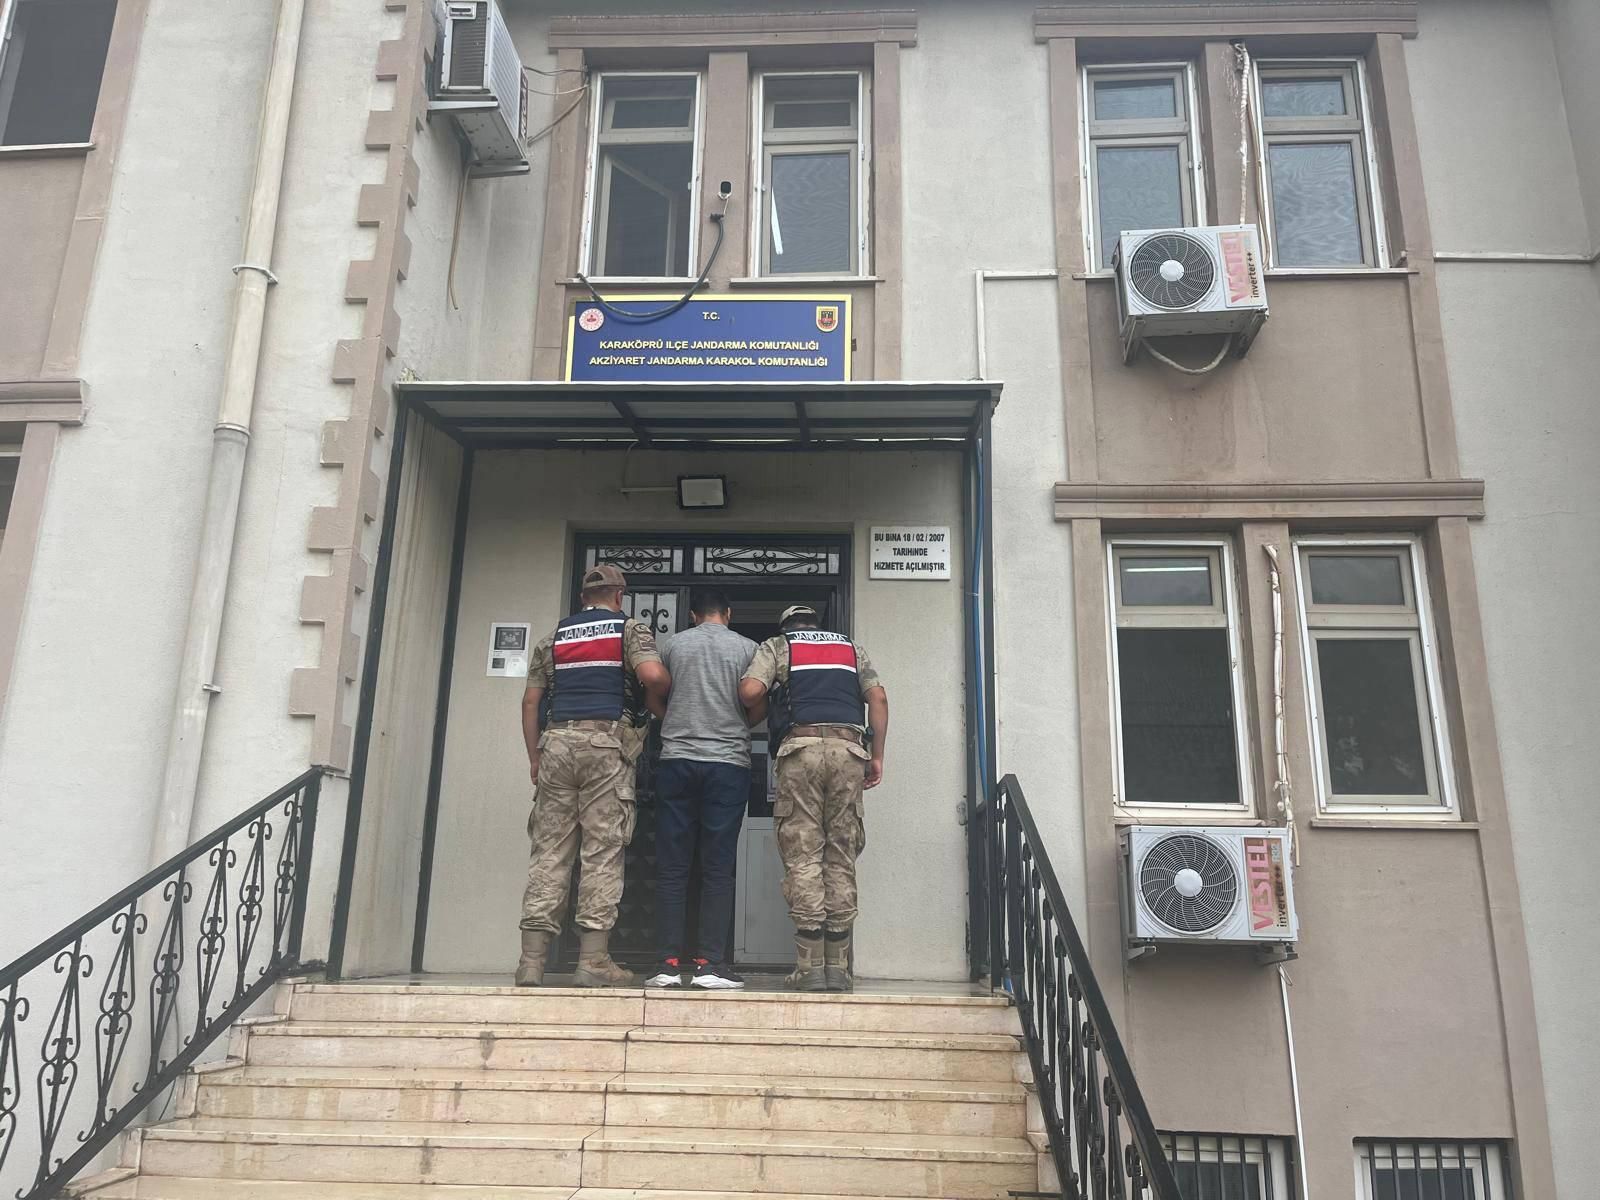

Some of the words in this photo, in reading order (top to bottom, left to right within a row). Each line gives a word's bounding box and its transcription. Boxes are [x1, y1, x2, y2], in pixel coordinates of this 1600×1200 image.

[702, 311, 720, 321] T.C.
[599, 339, 664, 350] KARAKÖPRÜ
[690, 340, 748, 350] JANDARMA
[749, 340, 819, 351] KOMUTANLIĞI
[589, 355, 646, 366] AKZİYARET
[647, 356, 704, 366] JANDARMA
[706, 357, 756, 366] KARAKOL
[758, 356, 828, 367] KOMUTANLIĞI
[874, 533, 884, 542] BU
[915, 533, 925, 542] 02
[929, 533, 945, 542] 2007
[561, 623, 616, 641] JANDARMA
[793, 631, 847, 642] JANDARMA
[1247, 839, 1273, 930] VESTEL
